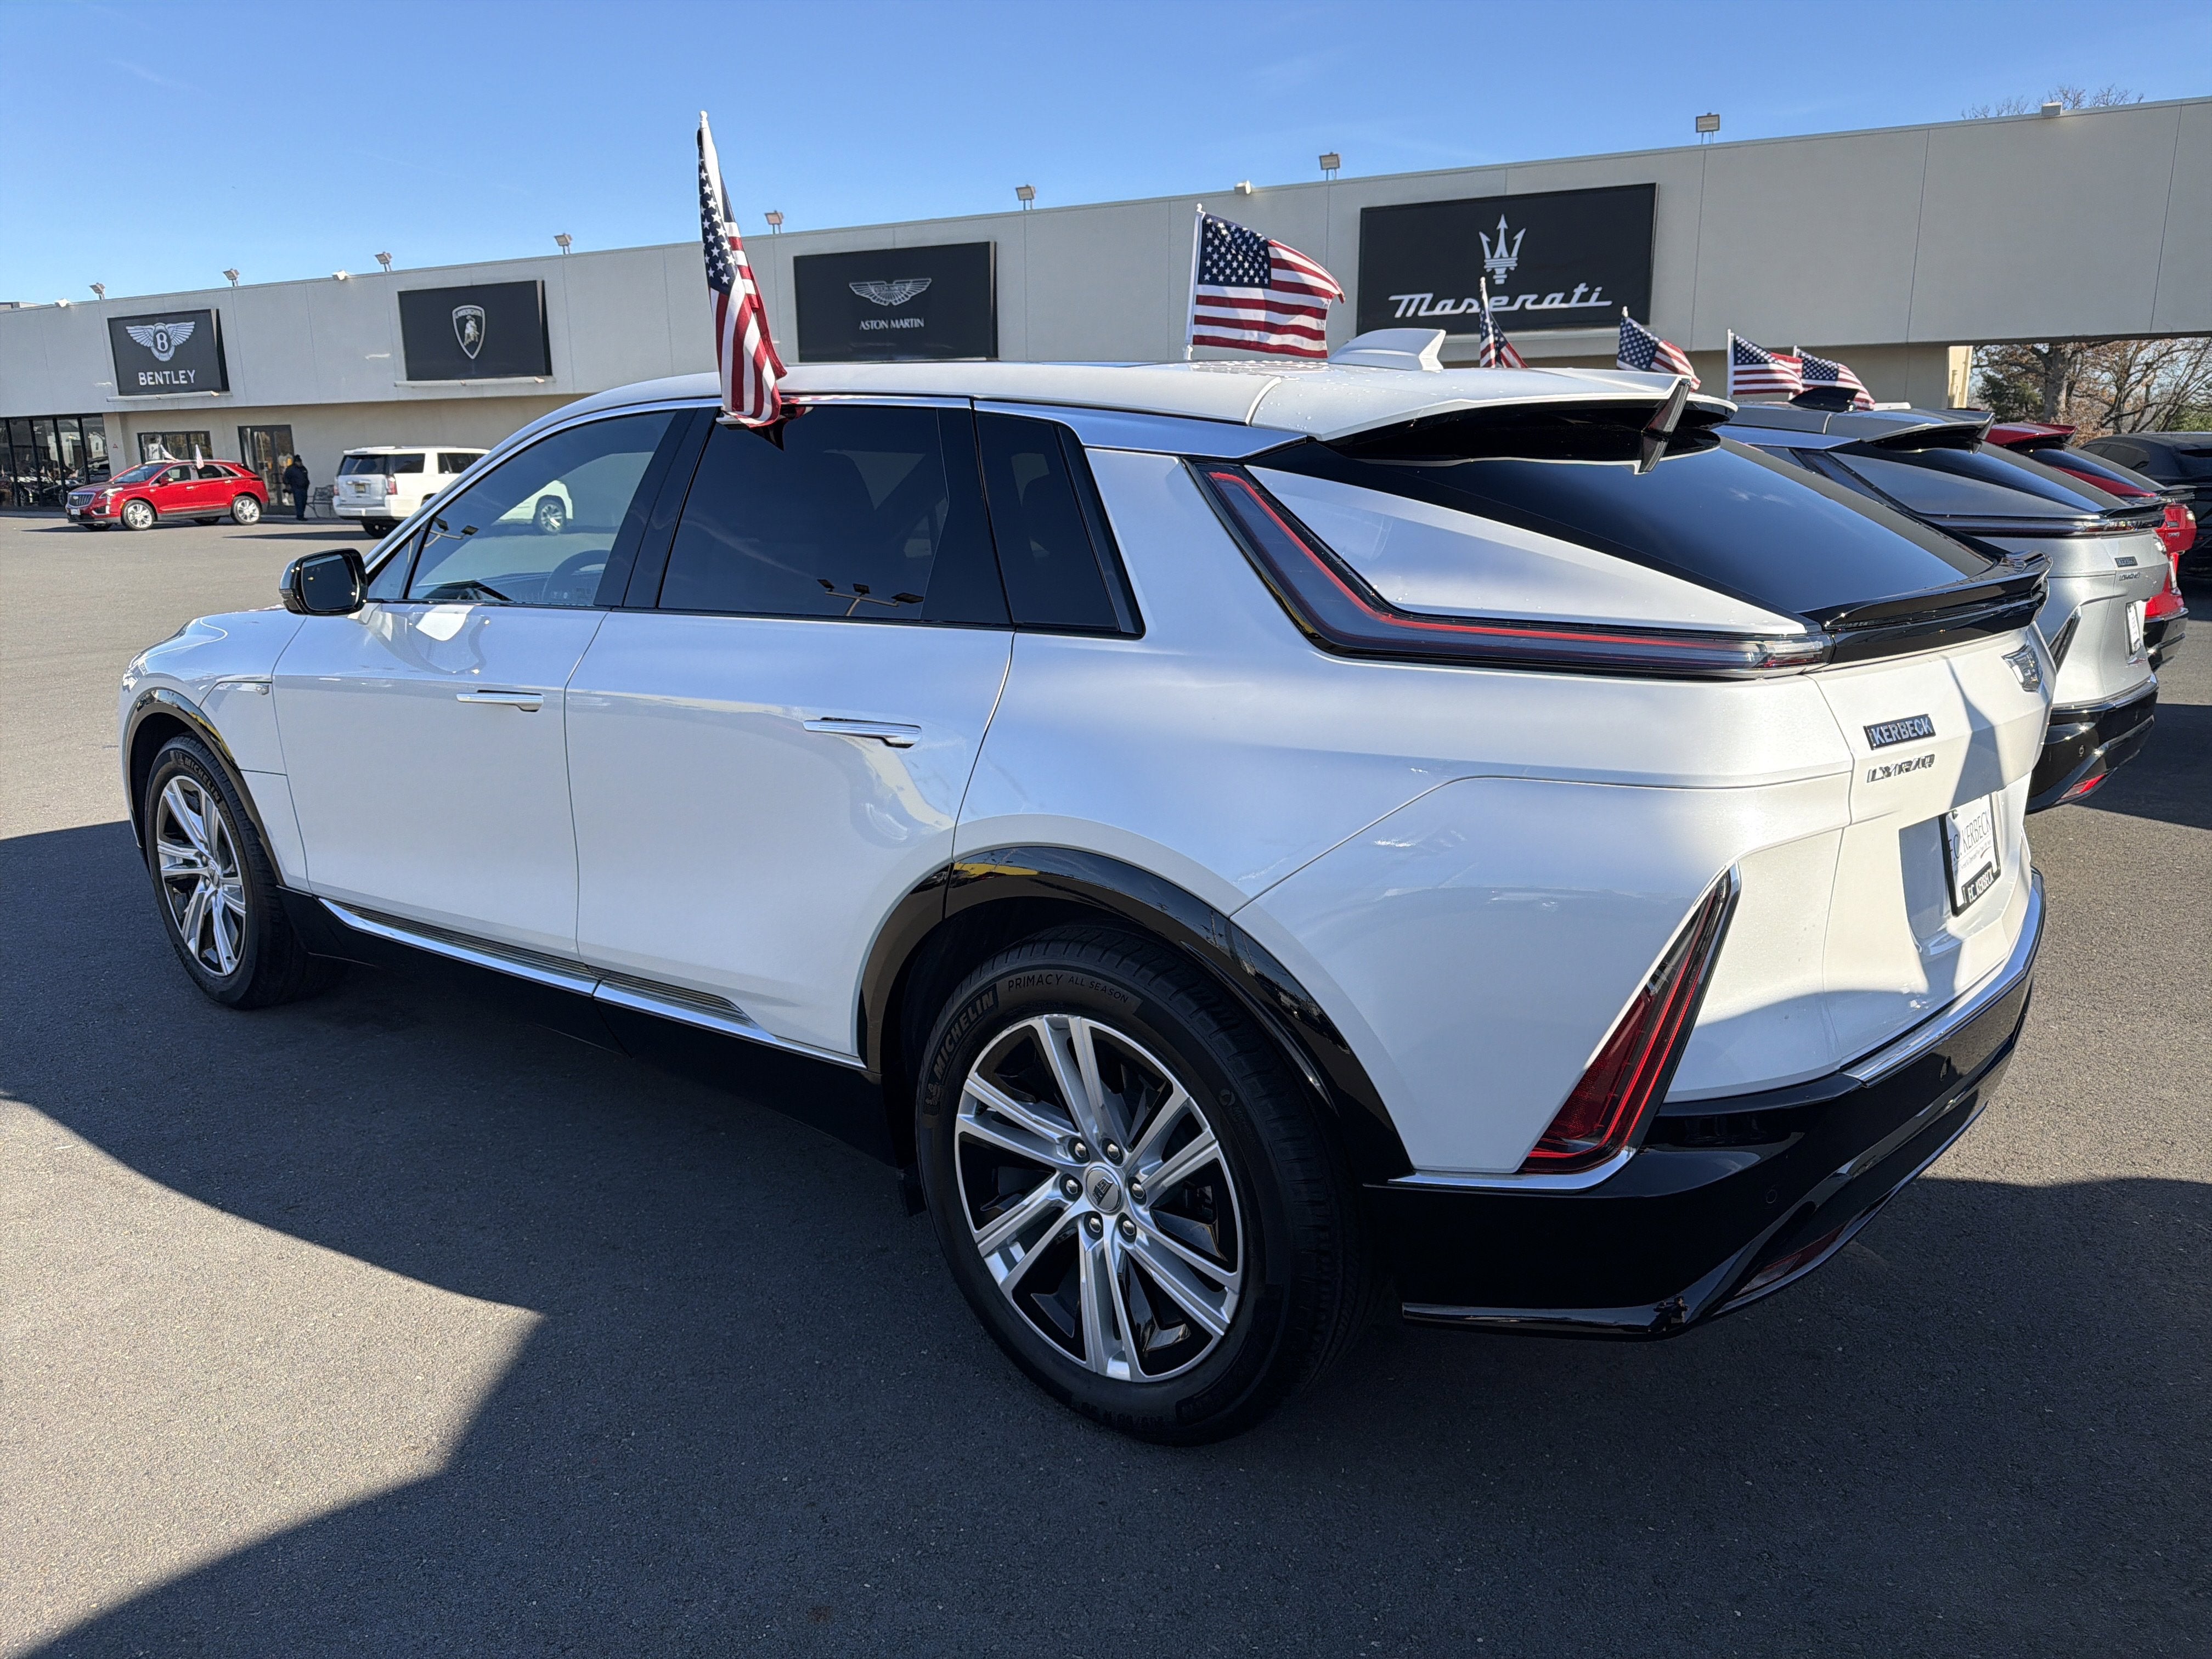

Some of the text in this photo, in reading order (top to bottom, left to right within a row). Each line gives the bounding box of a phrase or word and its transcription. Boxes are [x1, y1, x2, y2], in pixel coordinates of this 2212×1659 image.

[1388, 282, 1613, 318] Maserati
[859, 317, 924, 330] ASTON MARTIN
[155, 332, 169, 352] B
[138, 369, 196, 386] BENTLEY
[1871, 716, 1933, 745] KERBECK
[184, 757, 222, 802] MICHELIN
[1961, 809, 1991, 853] KERBECK
[1976, 866, 1994, 896] KERBECK
[1008, 973, 1129, 1003] PRIMACY ALL SEASON
[933, 990, 995, 1081] MICHELIN
